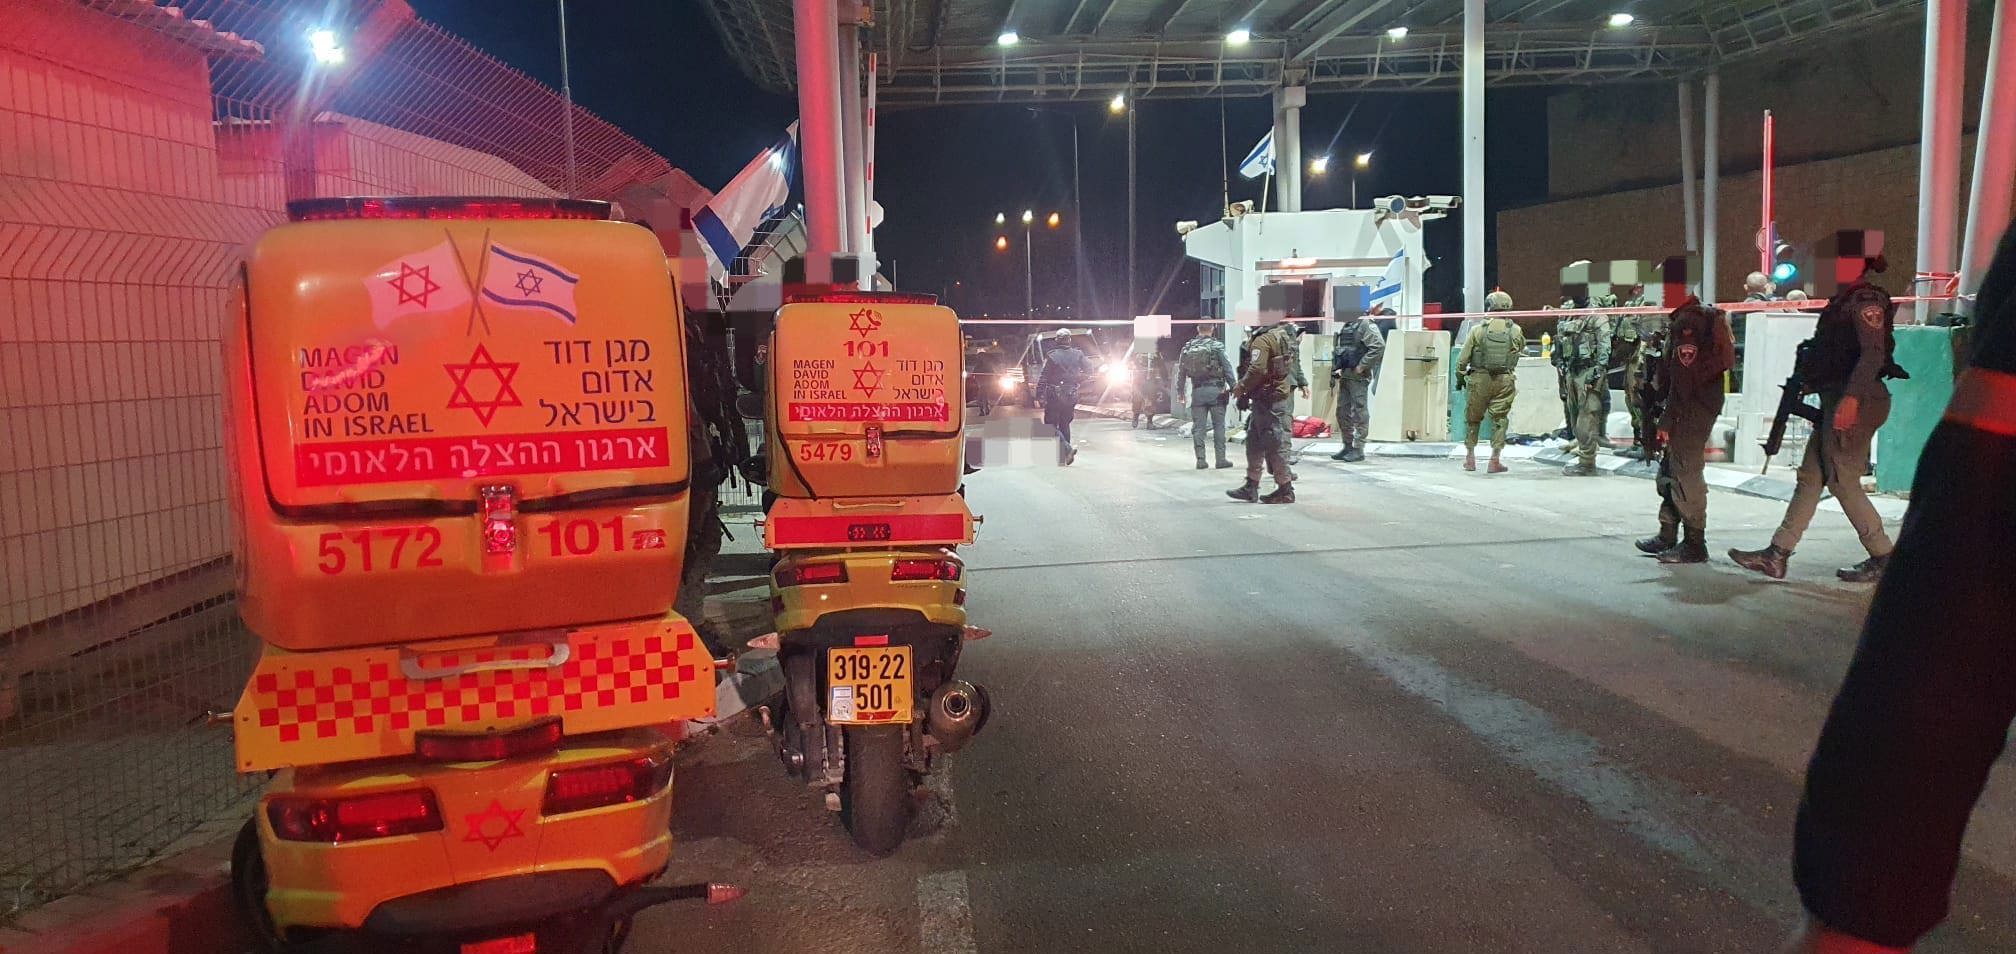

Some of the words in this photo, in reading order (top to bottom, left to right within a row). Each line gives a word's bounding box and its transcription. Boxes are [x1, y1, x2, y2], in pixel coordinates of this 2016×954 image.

[544, 340, 592, 365] דוד
[604, 339, 650, 367] מגן
[843, 340, 889, 357] 101
[793, 359, 835, 370] MAGEN
[793, 370, 829, 380] DAVID
[896, 360, 918, 372] דוד
[582, 368, 652, 394] אדום
[794, 380, 830, 390] ADOM
[911, 374, 944, 386] אדום
[304, 392, 390, 415] ADOM
[793, 390, 806, 400] IN
[809, 390, 848, 400] ISRAEL
[304, 417, 333, 438] IN
[344, 413, 434, 436] ISRAEL
[540, 399, 655, 427] בישראל
[308, 442, 434, 476] הלאומי
[576, 436, 657, 468] ארגון
[800, 443, 852, 462] 5479
[538, 515, 624, 558] 101
[317, 526, 444, 576] 5172
[834, 654, 905, 681] 319-22
[856, 683, 894, 710] 501
